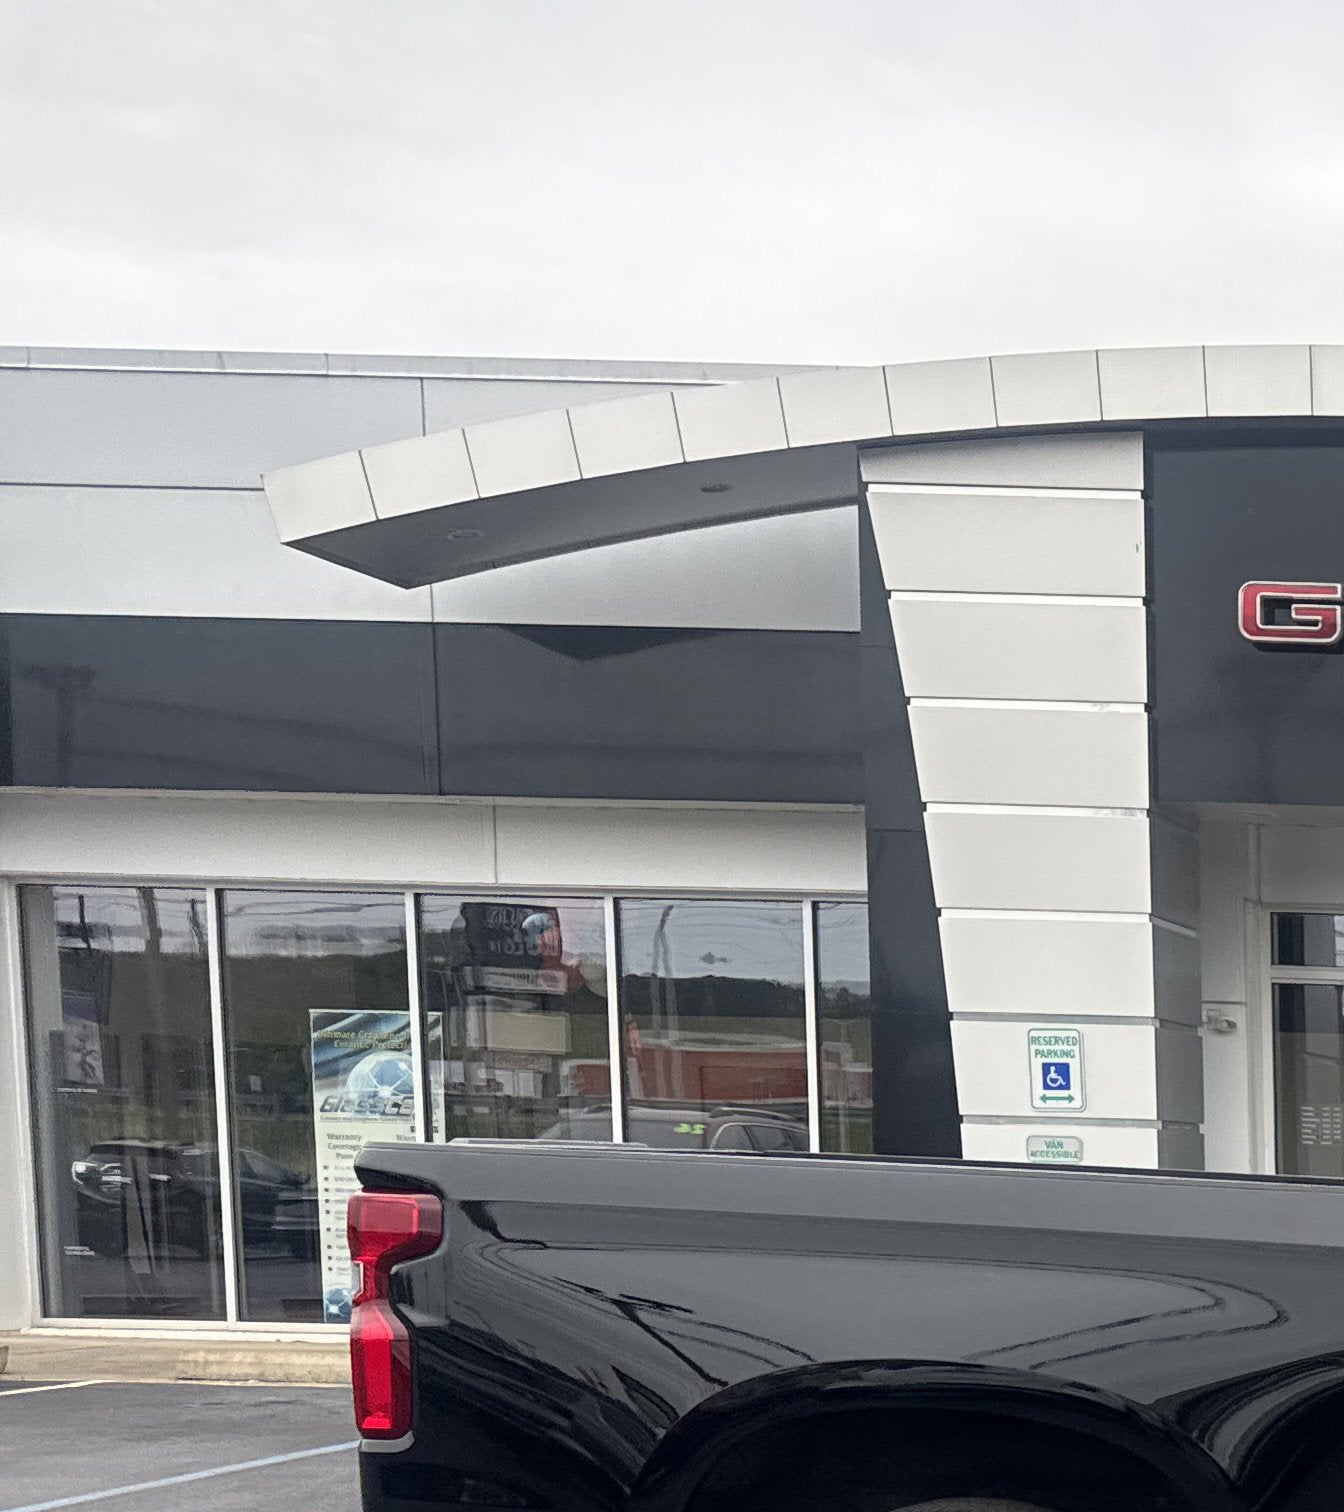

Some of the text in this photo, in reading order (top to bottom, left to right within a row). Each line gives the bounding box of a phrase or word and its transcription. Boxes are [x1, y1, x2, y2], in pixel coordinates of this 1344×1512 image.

[1030, 1035, 1079, 1047] RESERVED
[1034, 1048, 1076, 1059] PARKING
[327, 1143, 361, 1152] Coverag
[1044, 1139, 1064, 1150] VAN
[1029, 1150, 1080, 1159] ACCESSIBLE
